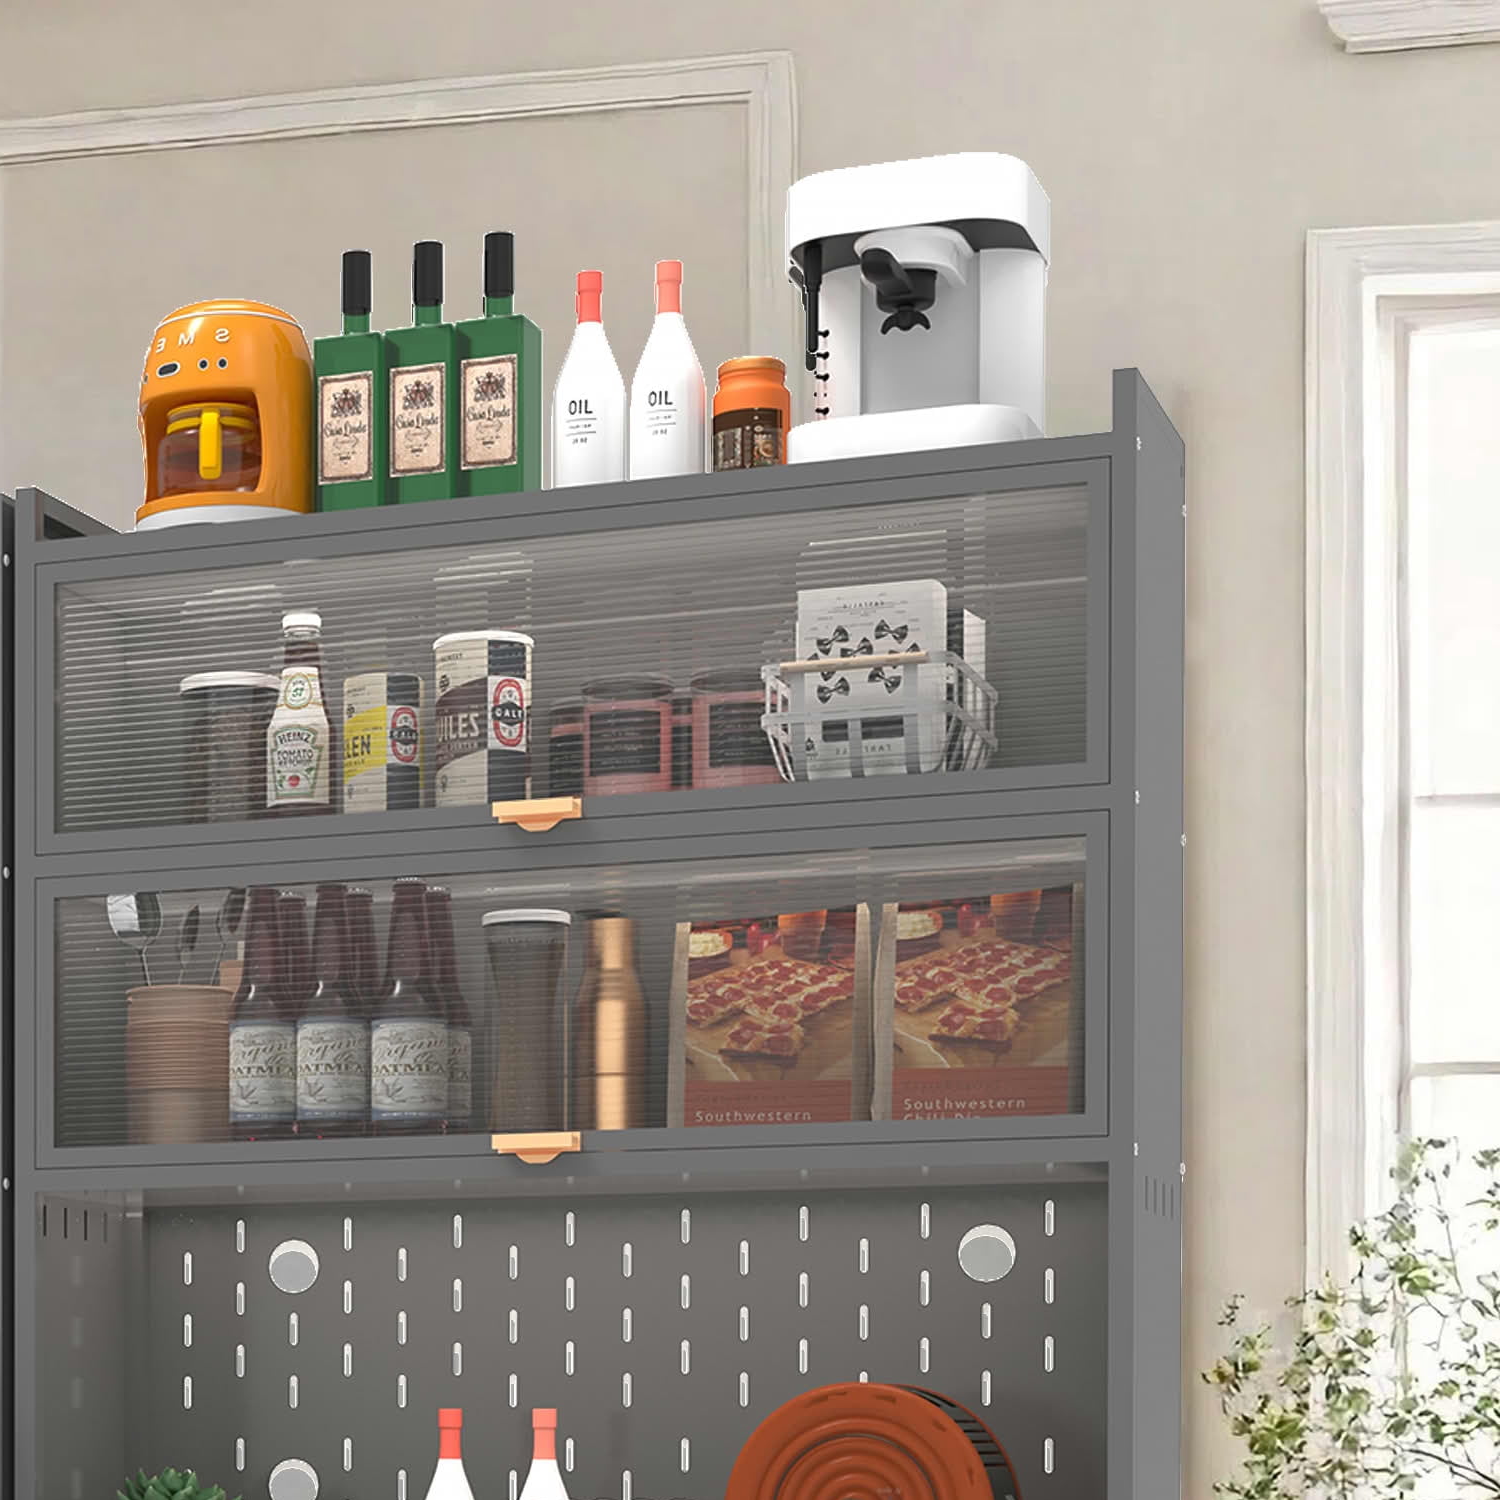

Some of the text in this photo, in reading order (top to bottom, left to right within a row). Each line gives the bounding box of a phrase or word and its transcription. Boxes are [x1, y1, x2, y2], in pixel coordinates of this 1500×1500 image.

[648, 390, 673, 406] OIL
[568, 399, 593, 415] OIL
[278, 732, 311, 745] HEINZ
[277, 749, 314, 761] TOMATO
[904, 1096, 1026, 1111] Southwestern
[695, 1110, 812, 1122] Southwestern
